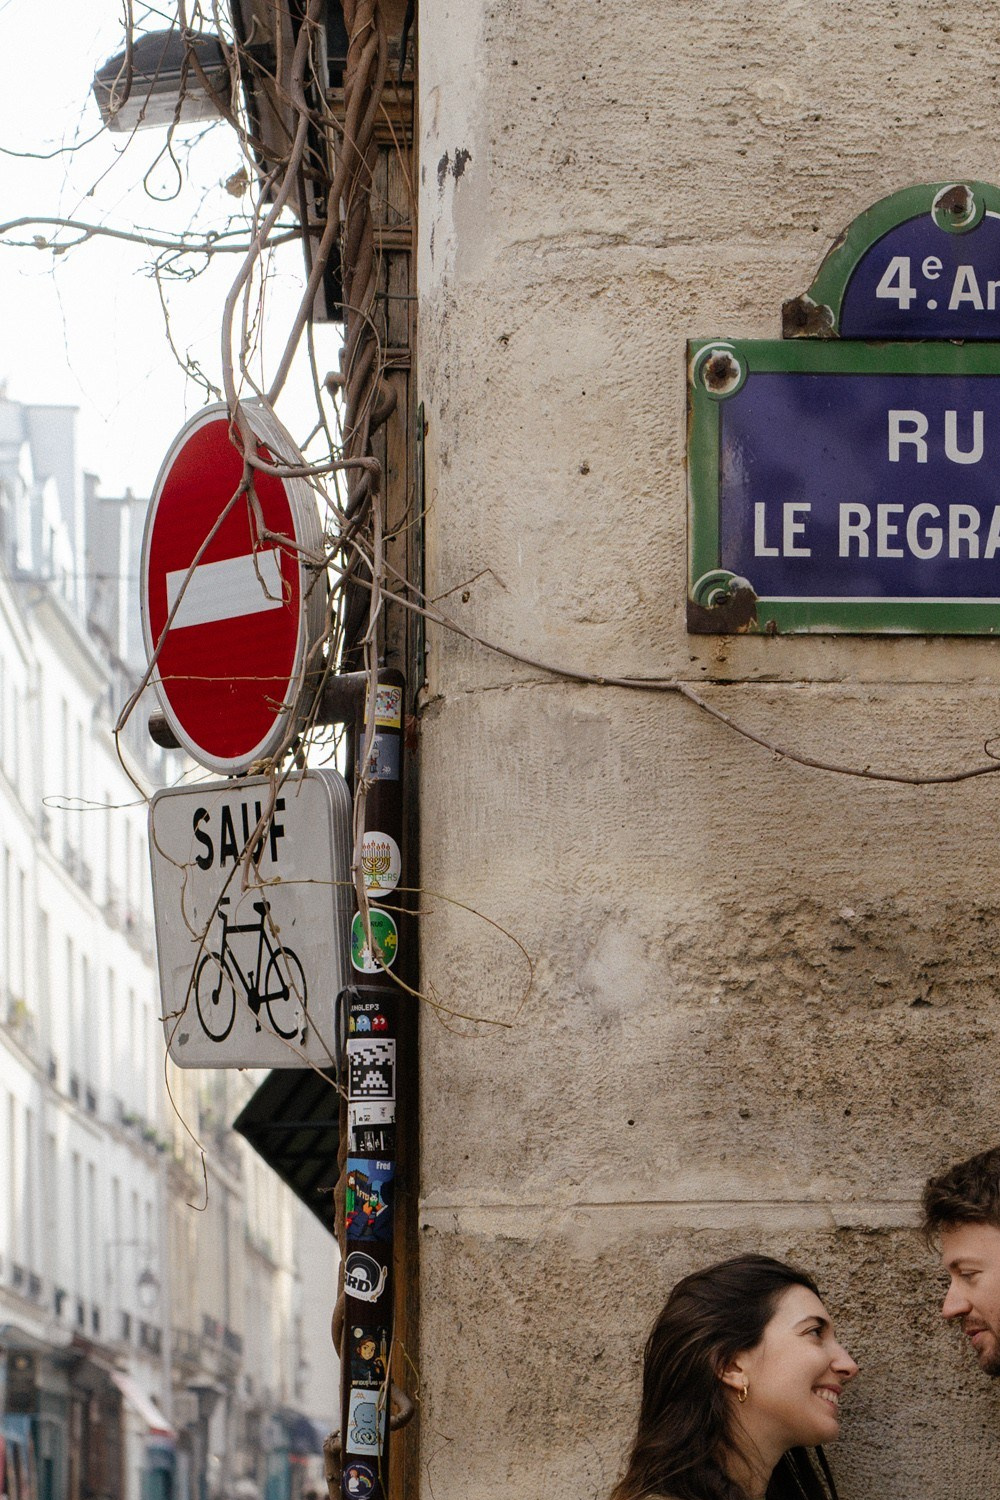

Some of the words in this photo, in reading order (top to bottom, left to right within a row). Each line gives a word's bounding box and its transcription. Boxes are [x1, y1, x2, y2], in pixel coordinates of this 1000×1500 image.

[754, 502, 811, 557] LE
[193, 798, 286, 870] SAUF
[376, 1161, 391, 1171] Fred
